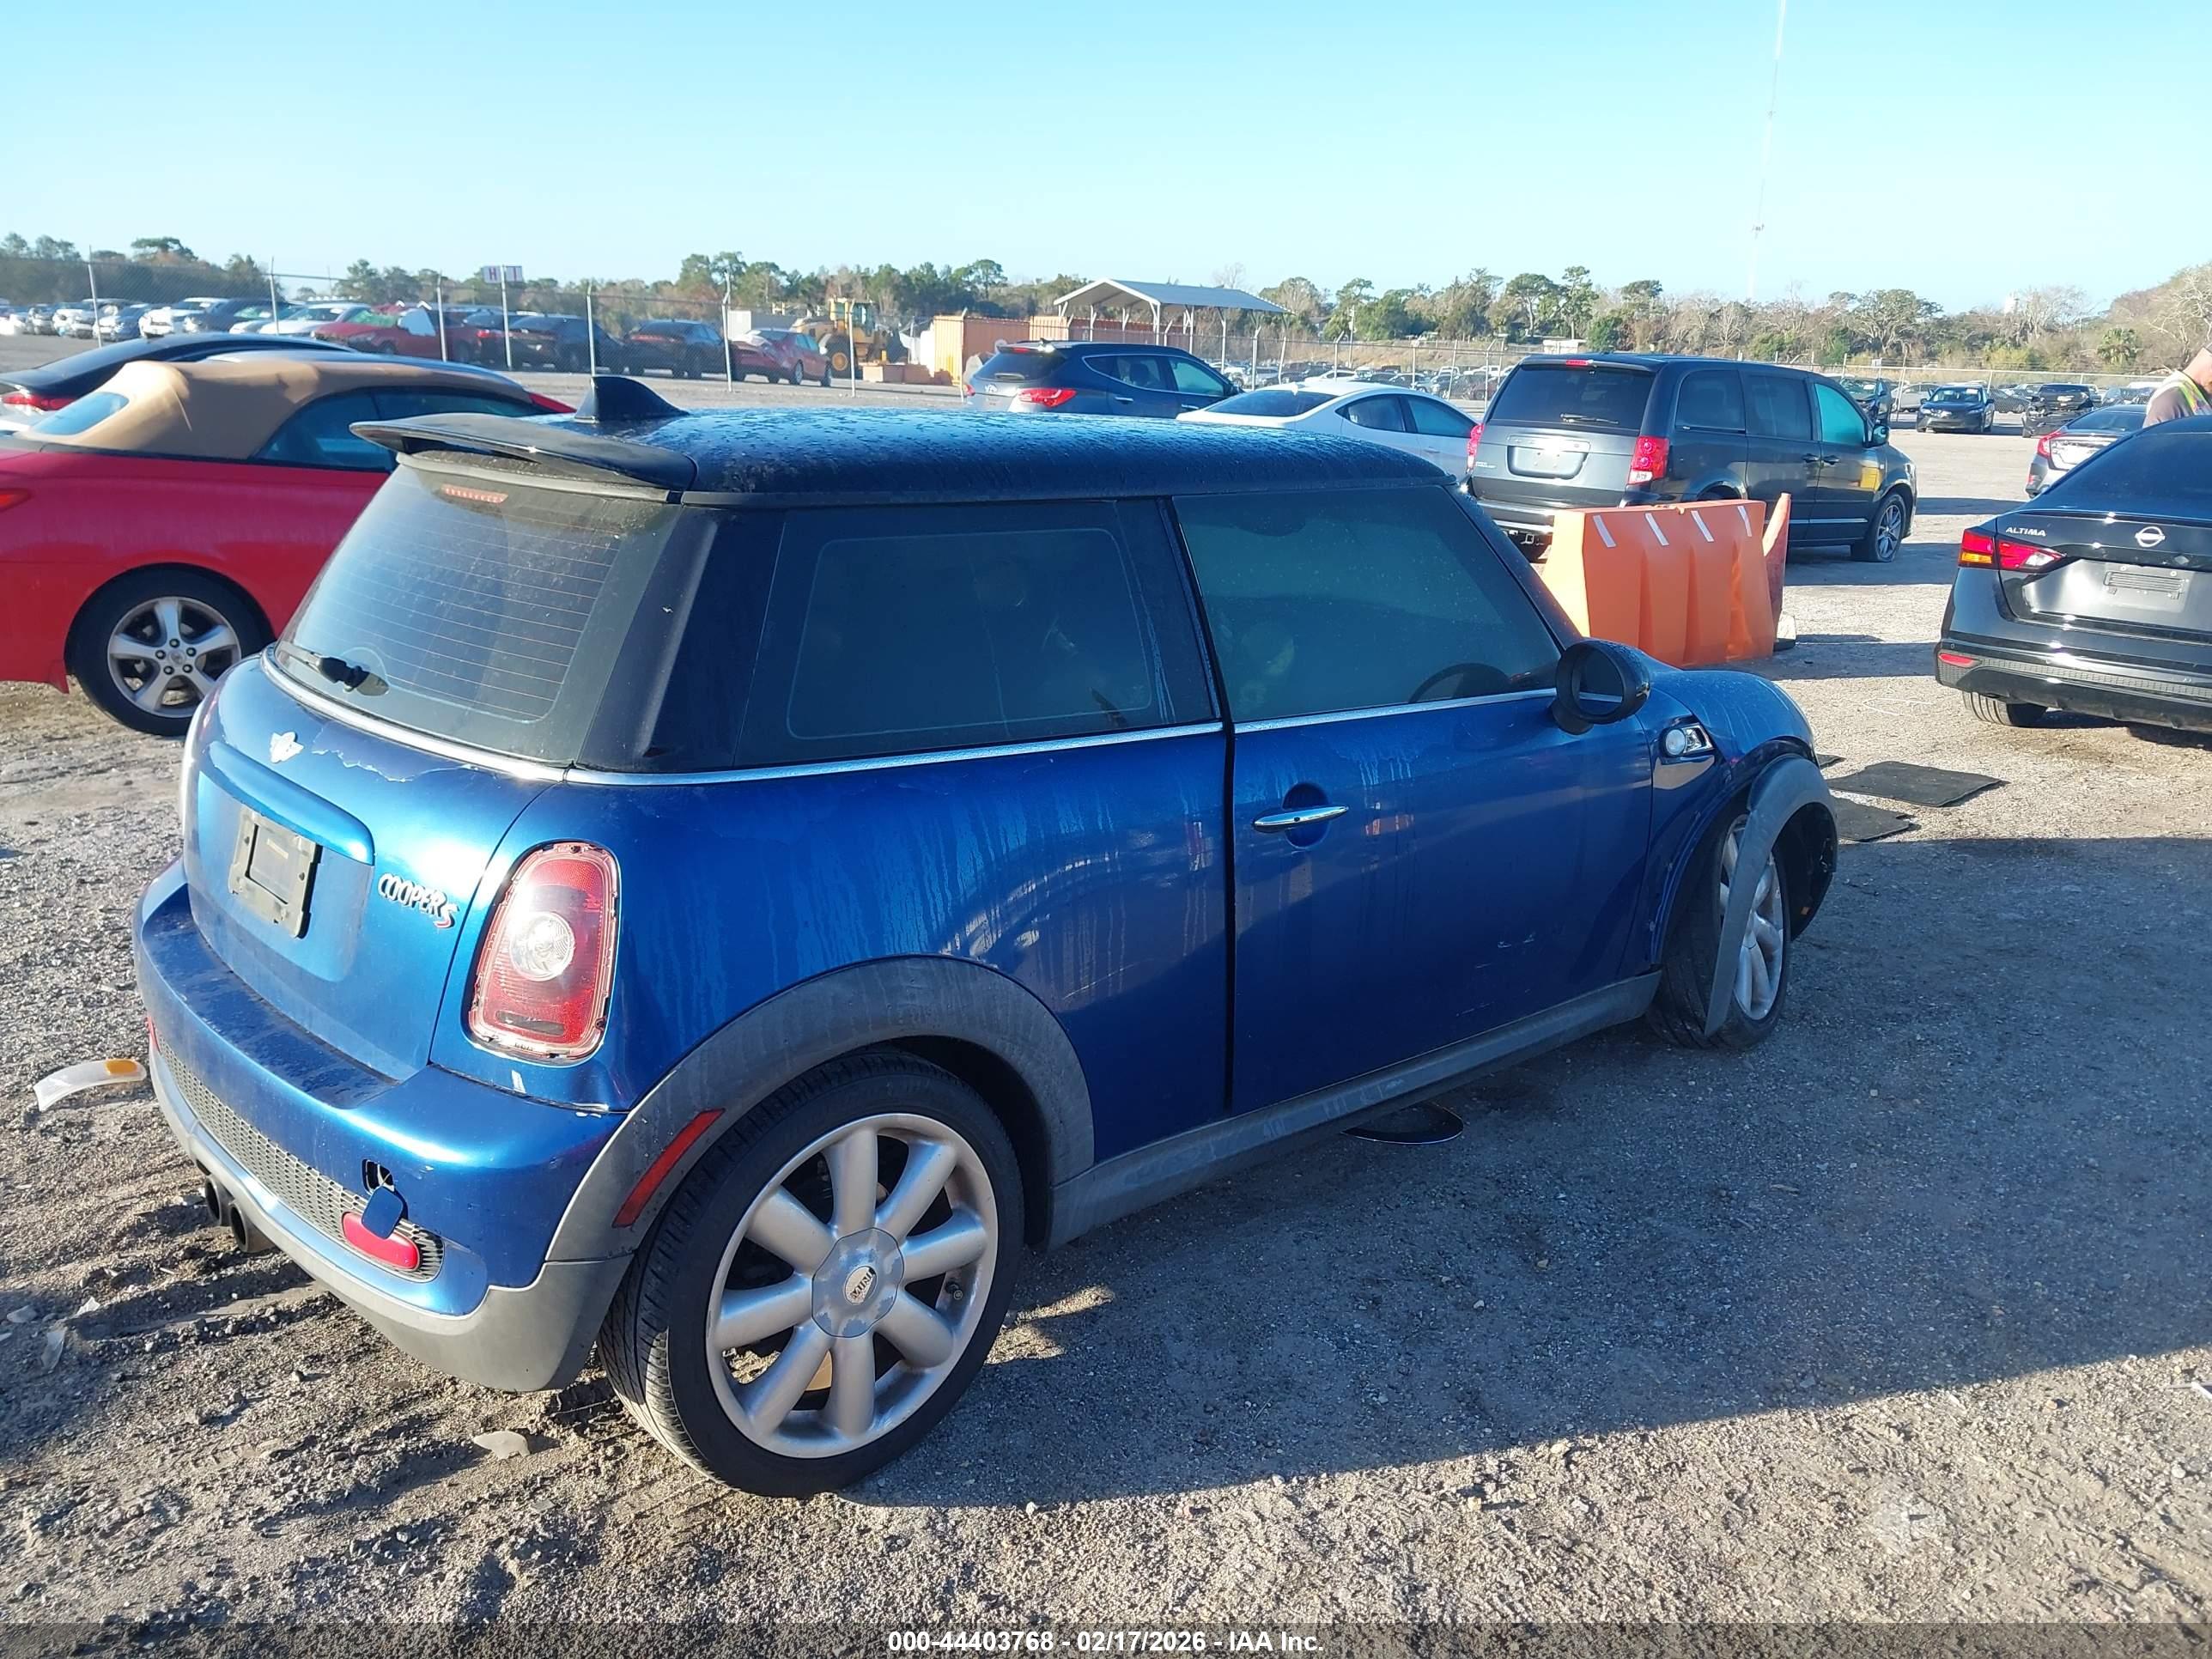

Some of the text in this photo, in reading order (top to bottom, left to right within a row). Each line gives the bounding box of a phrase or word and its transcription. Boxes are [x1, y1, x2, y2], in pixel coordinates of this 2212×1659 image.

[2005, 526, 2046, 537] ALTIMA
[378, 872, 460, 928] COOPER S
[850, 1271, 873, 1299] MINI
